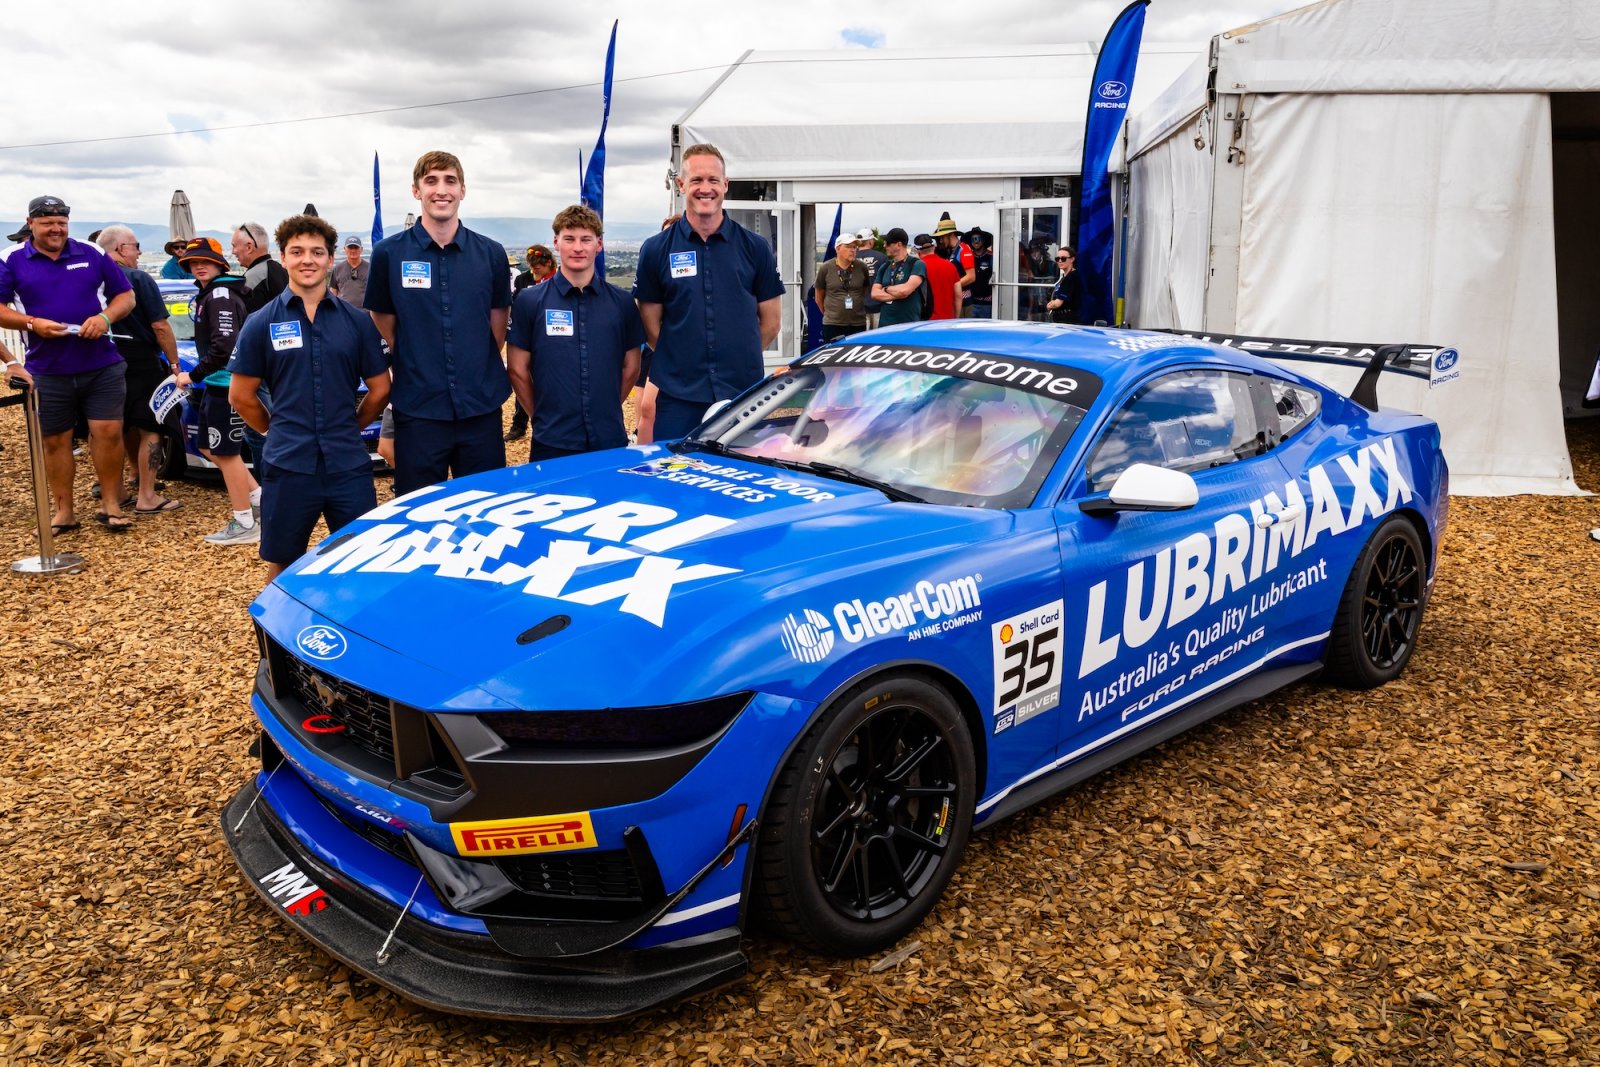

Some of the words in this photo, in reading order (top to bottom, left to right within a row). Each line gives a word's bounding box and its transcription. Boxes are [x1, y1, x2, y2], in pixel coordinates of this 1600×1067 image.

[1101, 82, 1124, 97] Ford
[835, 345, 1079, 396] Monochrome
[1437, 350, 1456, 370] Ford
[1432, 371, 1460, 386] RACING
[154, 384, 174, 409] Ford
[657, 470, 777, 503] SERVICES
[691, 463, 764, 481] ABLE
[752, 476, 836, 503] DOOR
[356, 486, 738, 553] LUBRI
[1078, 437, 1413, 680] LUBRIMAXX
[908, 630, 921, 642] AN
[922, 625, 941, 638] HME
[943, 610, 983, 631] COMPANY
[1020, 617, 1039, 634] Shell
[1041, 609, 1060, 625] Card
[300, 626, 342, 657] Ford
[1078, 641, 1180, 722] Australia's
[1185, 600, 1248, 657] Quality
[1250, 558, 1328, 619] Lubricant
[999, 627, 1059, 708] 35
[1122, 674, 1187, 722] FORD
[1189, 626, 1265, 681] RACING
[1018, 691, 1059, 718] SILVER
[460, 820, 585, 852] PIRELLI
